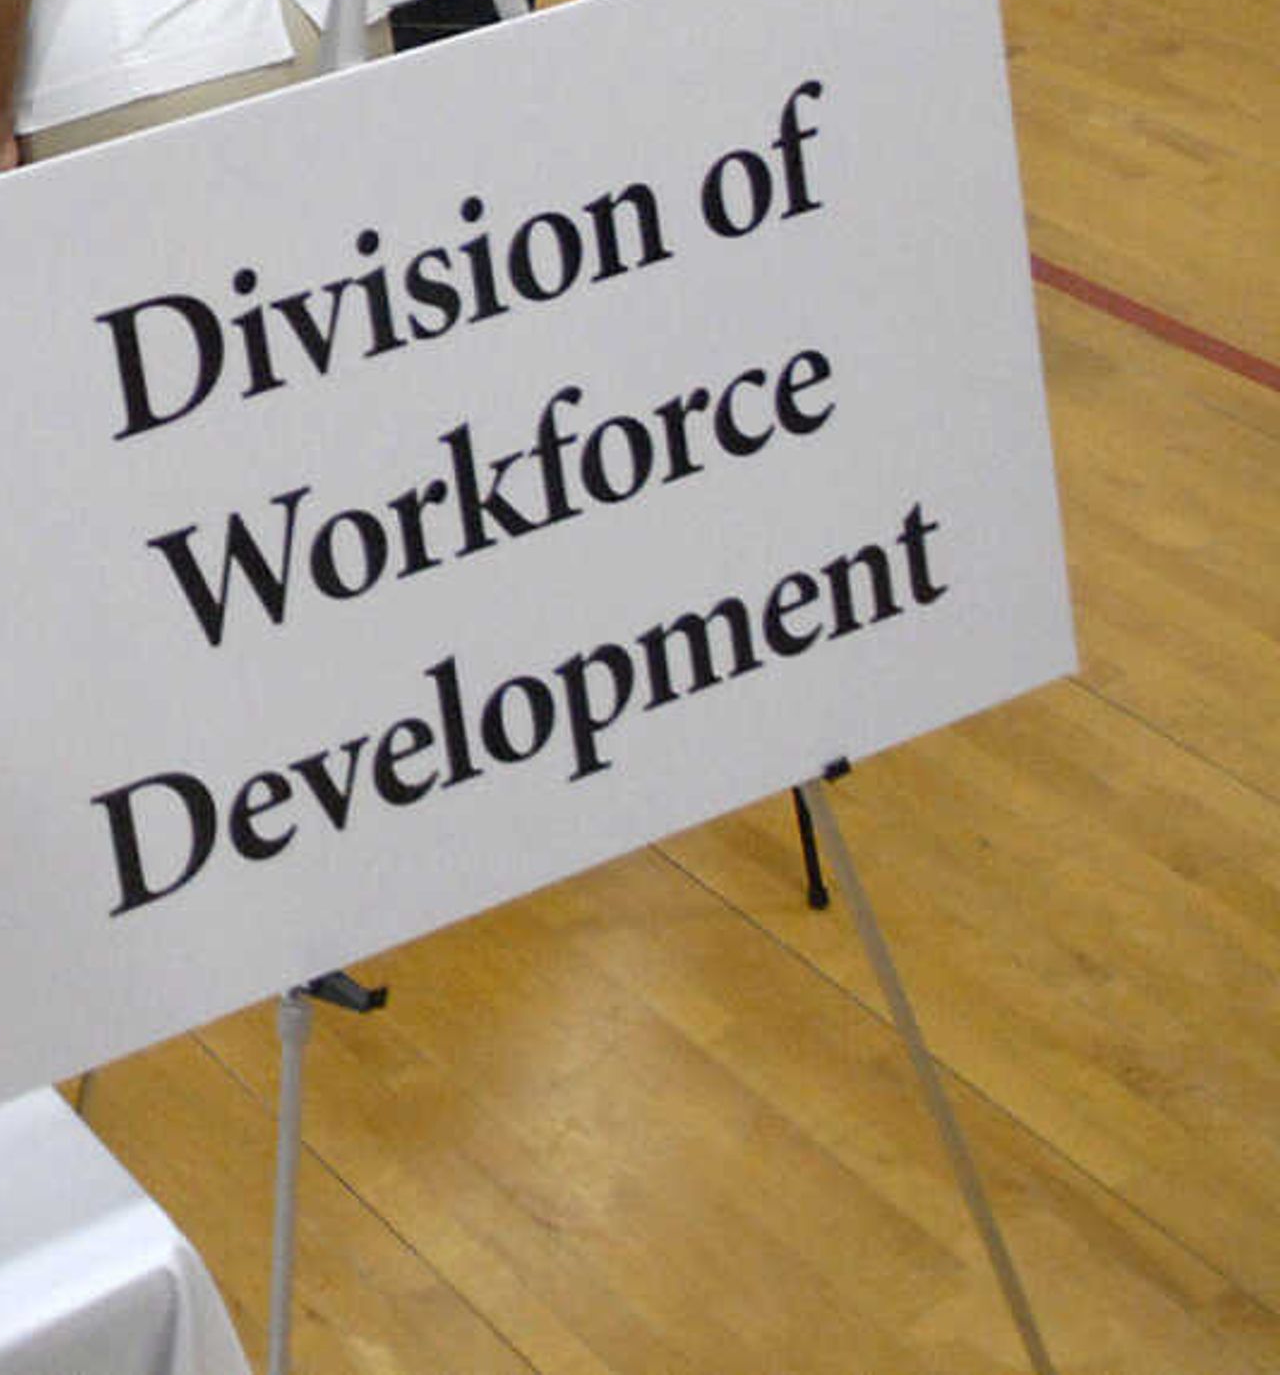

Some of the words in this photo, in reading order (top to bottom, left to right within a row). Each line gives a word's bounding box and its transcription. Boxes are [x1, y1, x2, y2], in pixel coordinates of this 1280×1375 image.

[96, 183, 673, 441] Division
[702, 81, 822, 237] of
[146, 344, 837, 648] Workforce
[90, 501, 949, 918] Development
